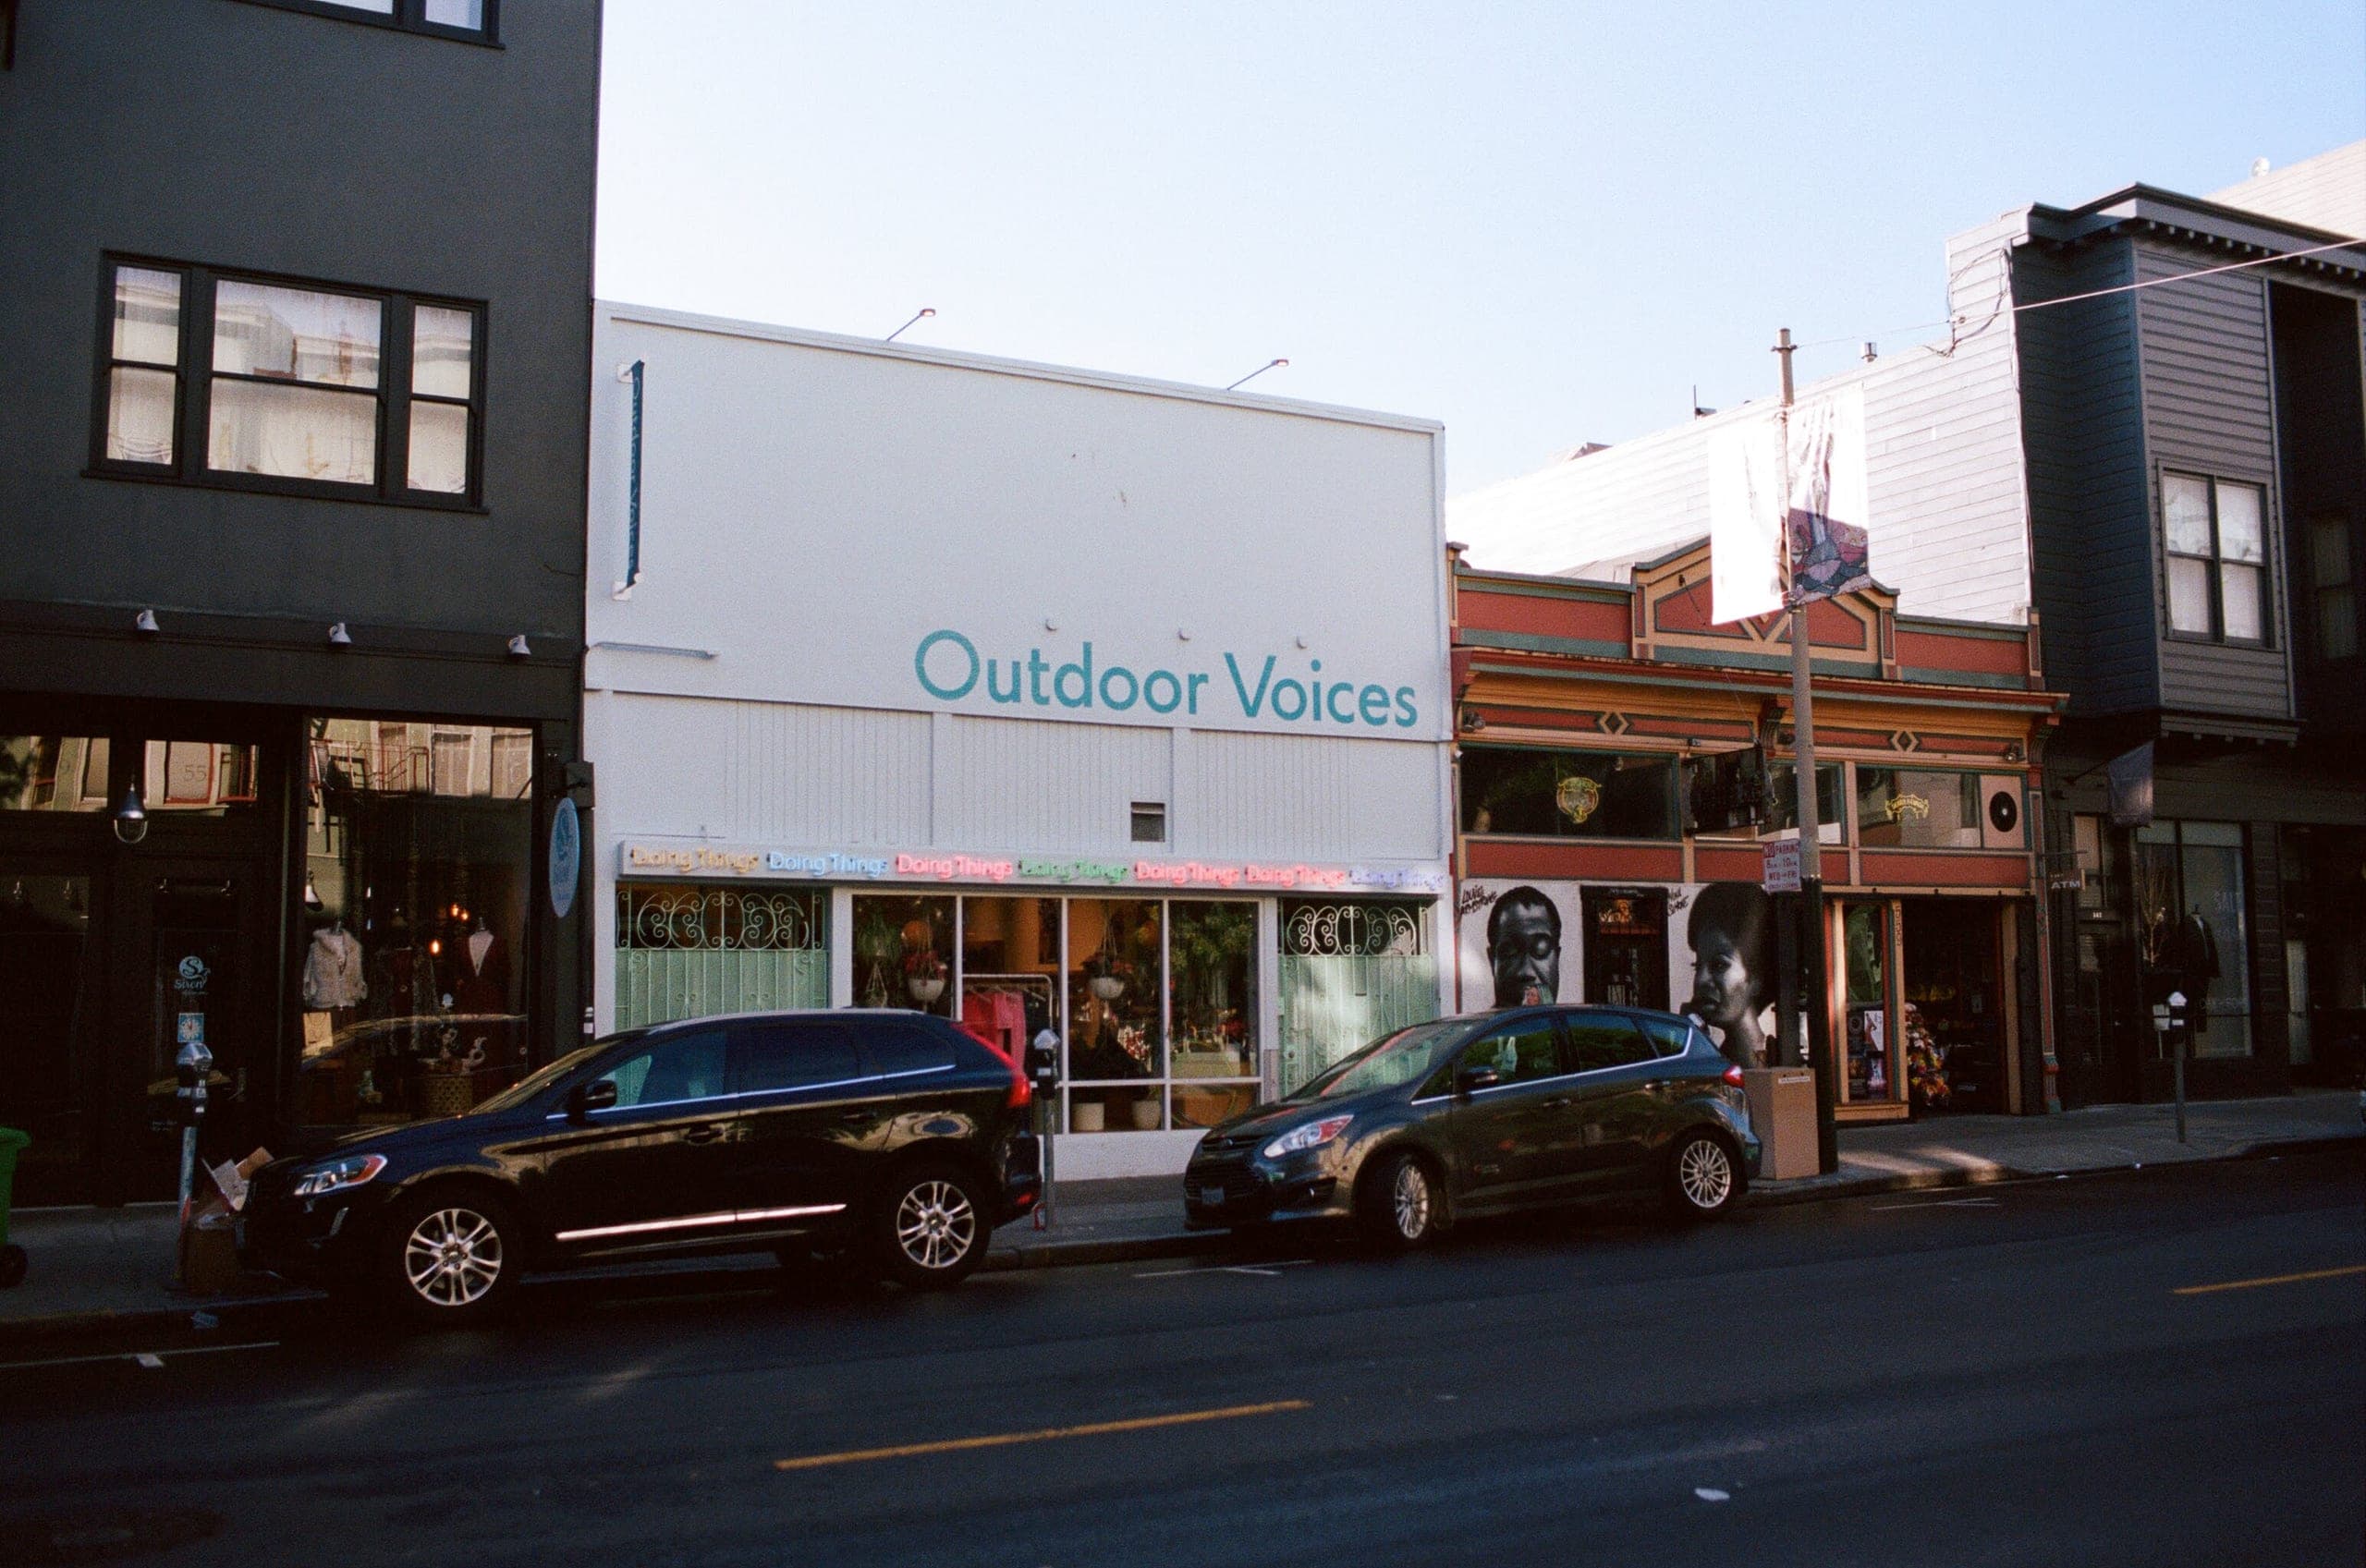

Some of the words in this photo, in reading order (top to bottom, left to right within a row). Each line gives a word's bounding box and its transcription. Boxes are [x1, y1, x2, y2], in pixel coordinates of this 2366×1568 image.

[915, 629, 1209, 714] Outdoor
[1224, 651, 1418, 728] Voices
[632, 845, 692, 870] Doing
[697, 847, 759, 873] Things
[768, 850, 825, 874] Doing
[830, 853, 889, 879] Things
[896, 852, 953, 879] Doing
[957, 855, 1014, 880] Things
[1135, 860, 1187, 885] Doing
[1187, 862, 1239, 887] Things
[2051, 880, 2080, 890] ATM
